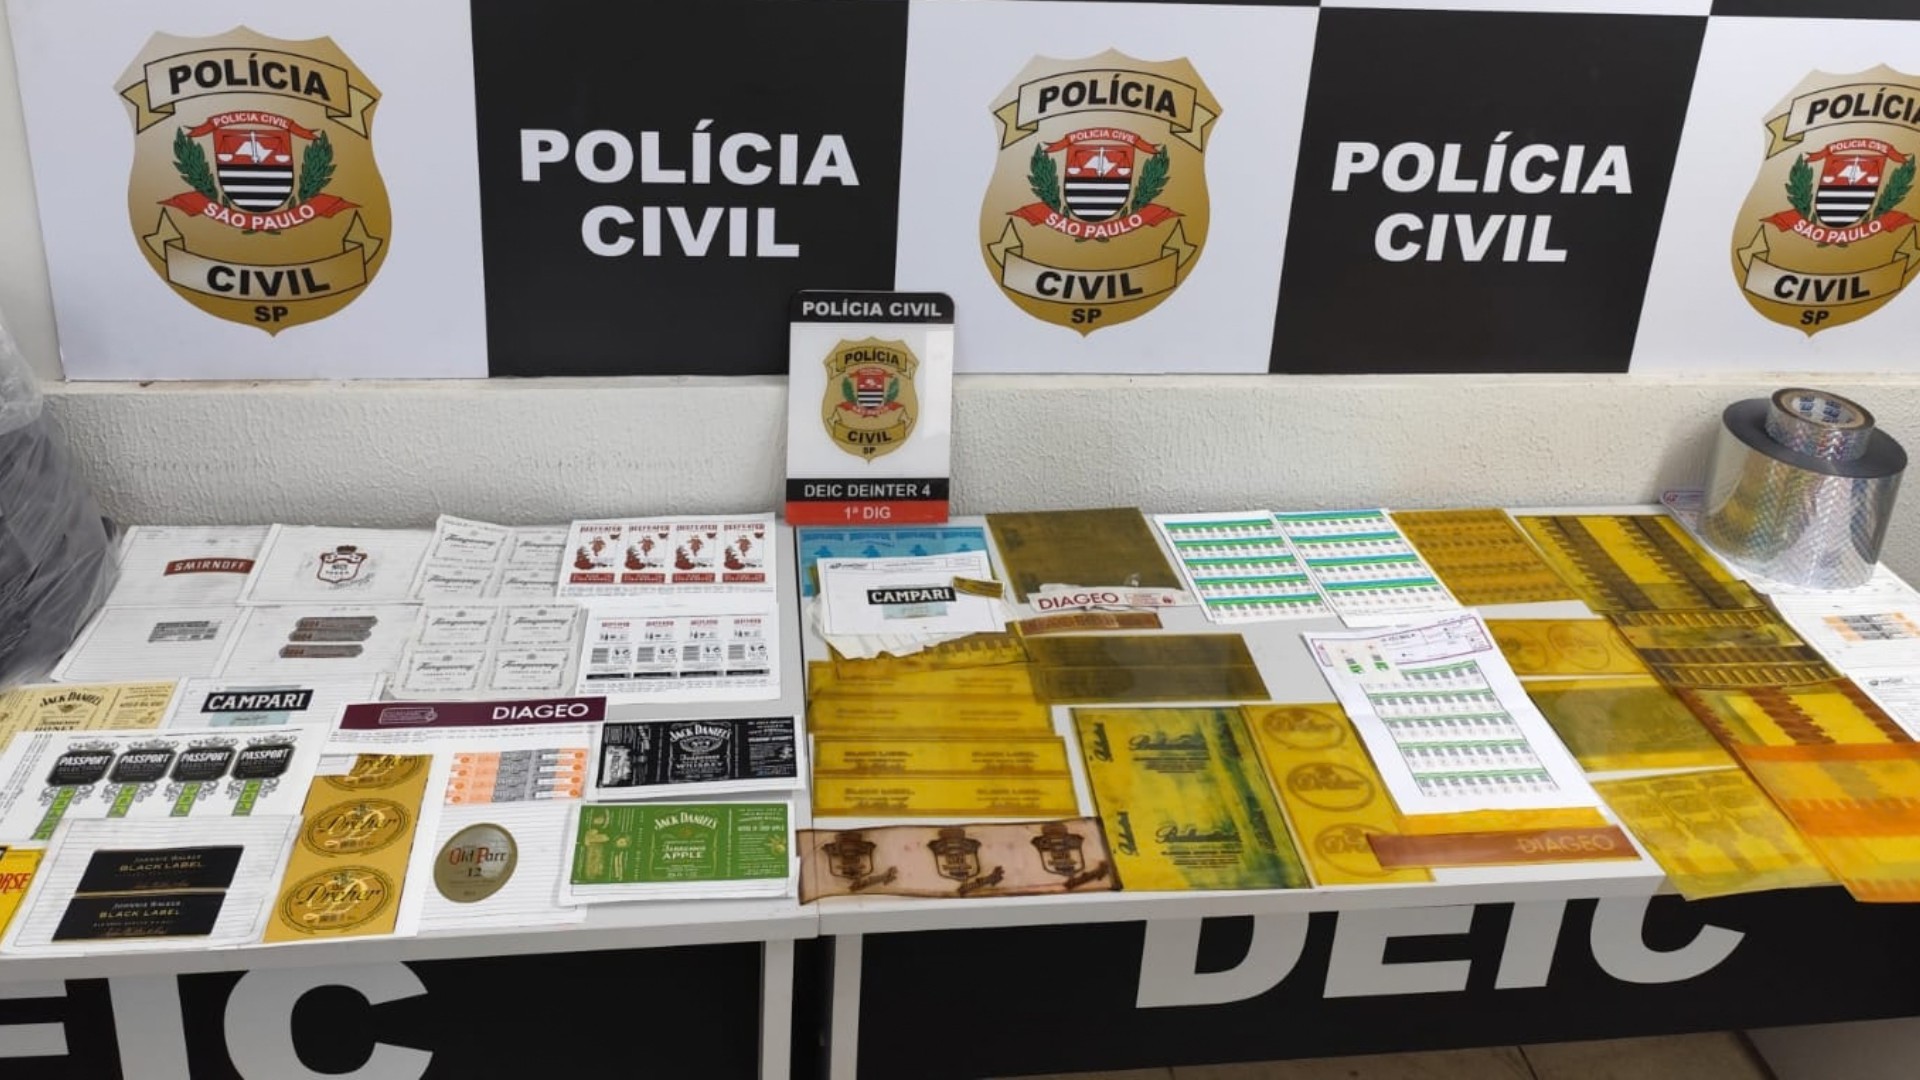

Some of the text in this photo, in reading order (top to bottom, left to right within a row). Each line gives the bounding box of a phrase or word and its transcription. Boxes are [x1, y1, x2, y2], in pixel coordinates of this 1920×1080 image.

[169, 52, 331, 102] POLÍCIA
[1038, 73, 1177, 118] POLÍCIA
[260, 113, 289, 129] CIVIL
[1111, 130, 1136, 145] CIVIL
[520, 119, 860, 188] POLÍCIA
[1331, 131, 1634, 195] POLÍCIA
[203, 202, 316, 231] SÃO PAULO
[580, 205, 801, 259] CIVIL
[1045, 212, 1143, 239] SÃO PAULO
[1793, 218, 1883, 244] SÃO PAULO
[1374, 212, 1568, 263] CIVIL
[206, 265, 331, 297] CIVIL
[1035, 271, 1144, 300] CIVIL
[1773, 275, 1871, 302] CIVIL
[254, 305, 288, 323] SP
[802, 298, 943, 317] POLÍCIA CIVIL
[1071, 308, 1102, 324] SP
[1800, 310, 1830, 325] SP
[844, 348, 899, 365] POLÍCIA
[847, 430, 893, 444] CIVIL
[803, 484, 931, 498] DEIC DEINTER 4
[863, 506, 892, 519] DIG
[174, 559, 246, 573] SMIRNOFF
[871, 588, 950, 603] CAMPARI
[1038, 592, 1119, 610] DIAGEO
[39, 694, 66, 708] JACK
[208, 692, 305, 710] CAMPARI
[492, 703, 589, 720] DIAGEO
[669, 728, 693, 742] JACK
[58, 754, 110, 766] PASSPORT
[121, 753, 170, 765] PASSPORT
[180, 751, 229, 763] PASSPORT
[241, 748, 289, 760] PASSPORT
[654, 815, 679, 830] JACK
[1518, 834, 1614, 853] DIAGEO
[449, 846, 508, 866] Old Parr
[662, 851, 704, 860] APPLE
[119, 860, 205, 872] BLACK LABEL
[467, 867, 483, 878] 12
[99, 909, 180, 919] BLACK LABEL
[1135, 893, 1746, 1008] DEIC
